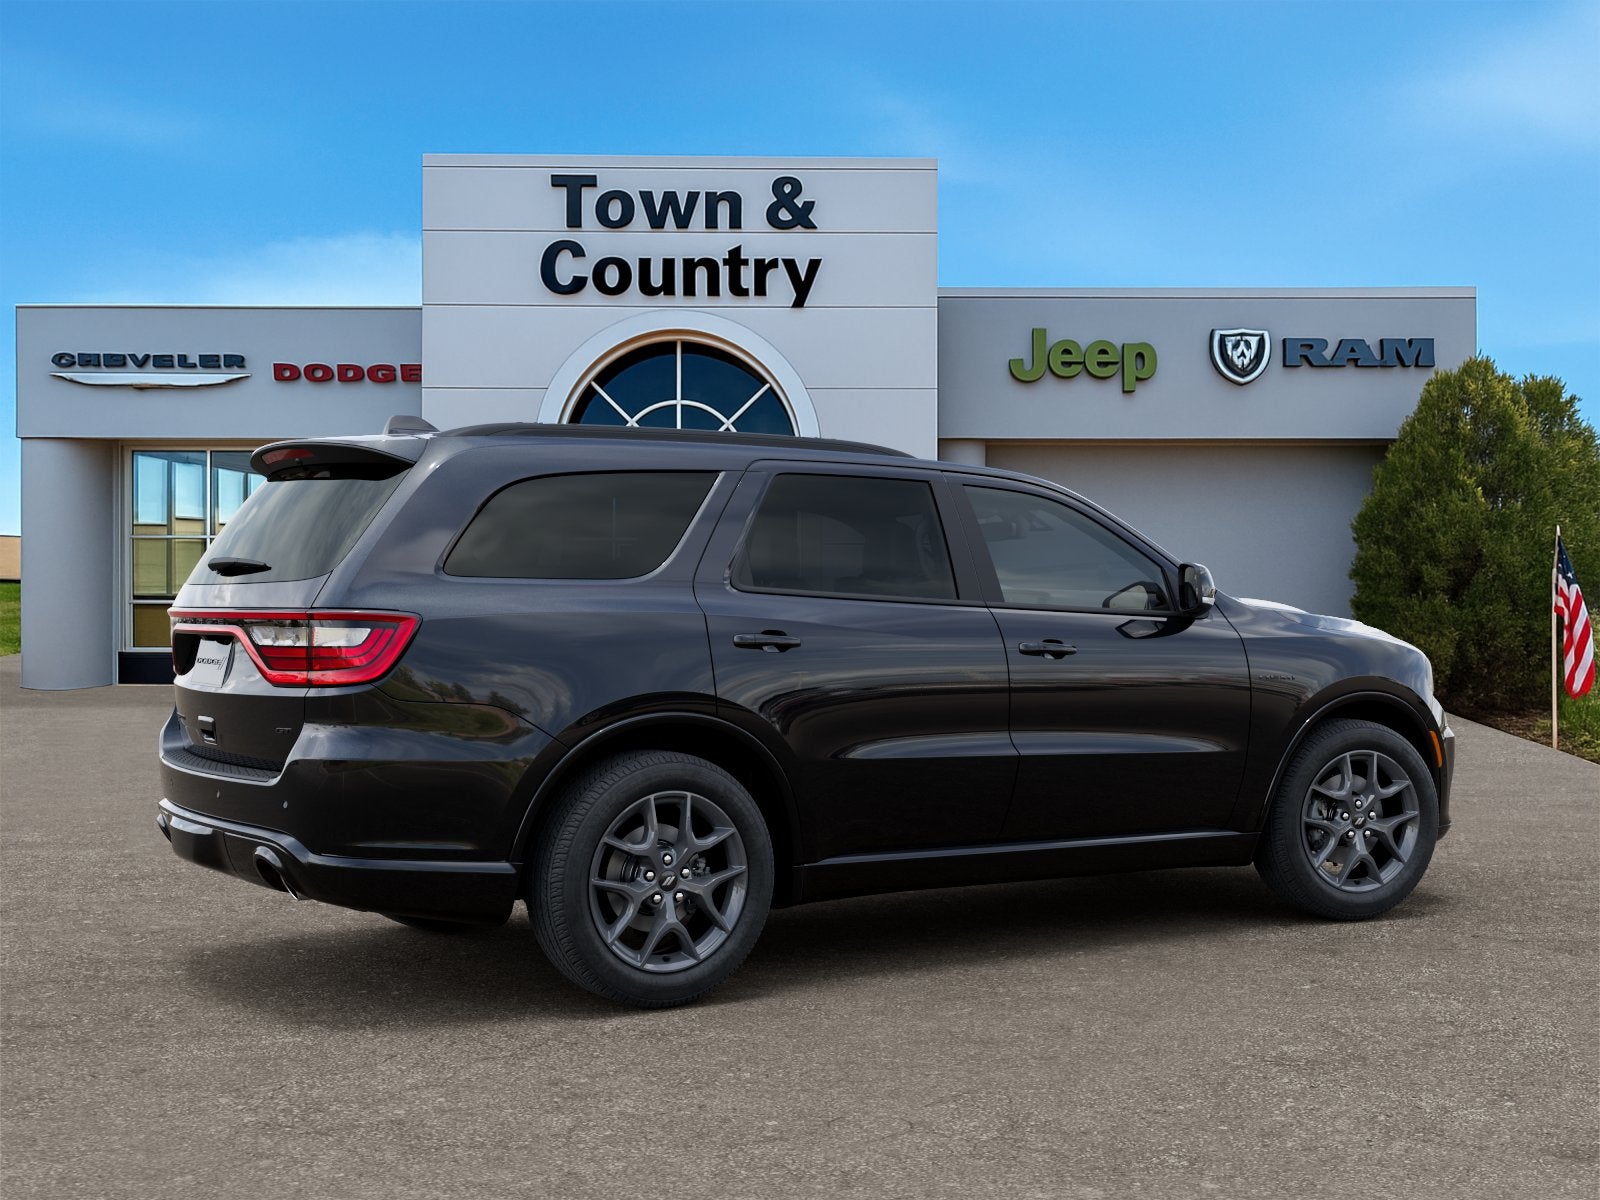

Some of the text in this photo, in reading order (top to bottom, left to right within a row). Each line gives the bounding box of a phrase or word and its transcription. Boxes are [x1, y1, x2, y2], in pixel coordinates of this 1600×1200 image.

[550, 174, 818, 230] Town &
[540, 239, 822, 308] Country
[273, 363, 422, 383] DODGE
[1008, 328, 1157, 393] Jeep
[1282, 338, 1435, 367] RAM
